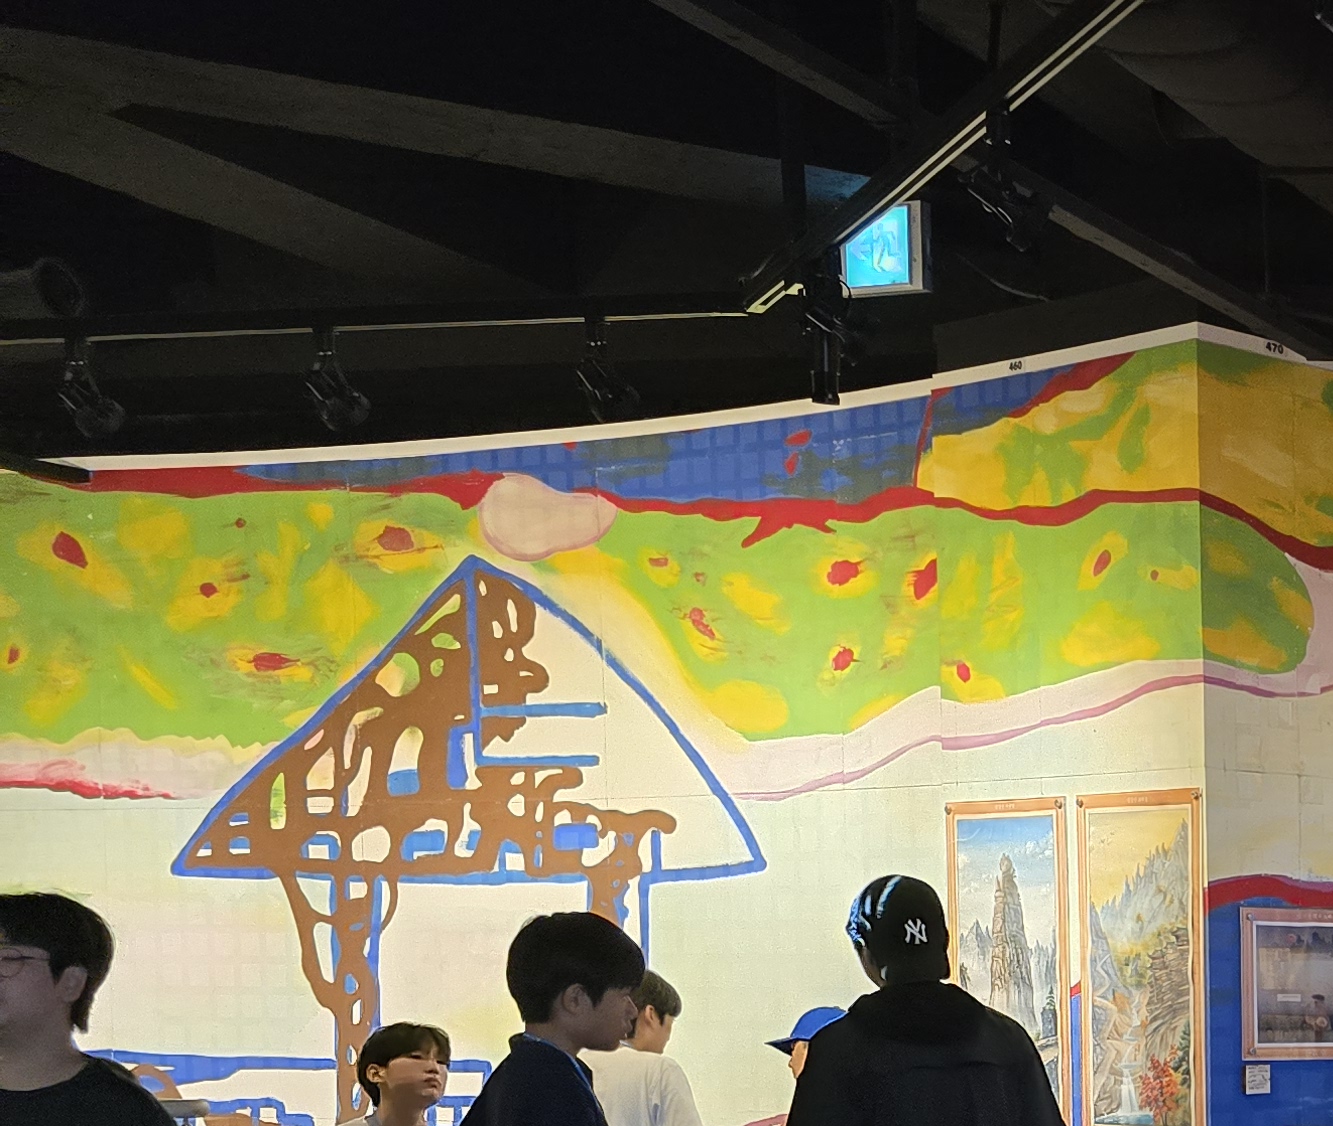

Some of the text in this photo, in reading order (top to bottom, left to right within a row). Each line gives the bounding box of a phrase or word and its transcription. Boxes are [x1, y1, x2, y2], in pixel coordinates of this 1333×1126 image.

[1265, 341, 1284, 355] 470
[1008, 360, 1023, 372] 460
[904, 918, 928, 945] NY
